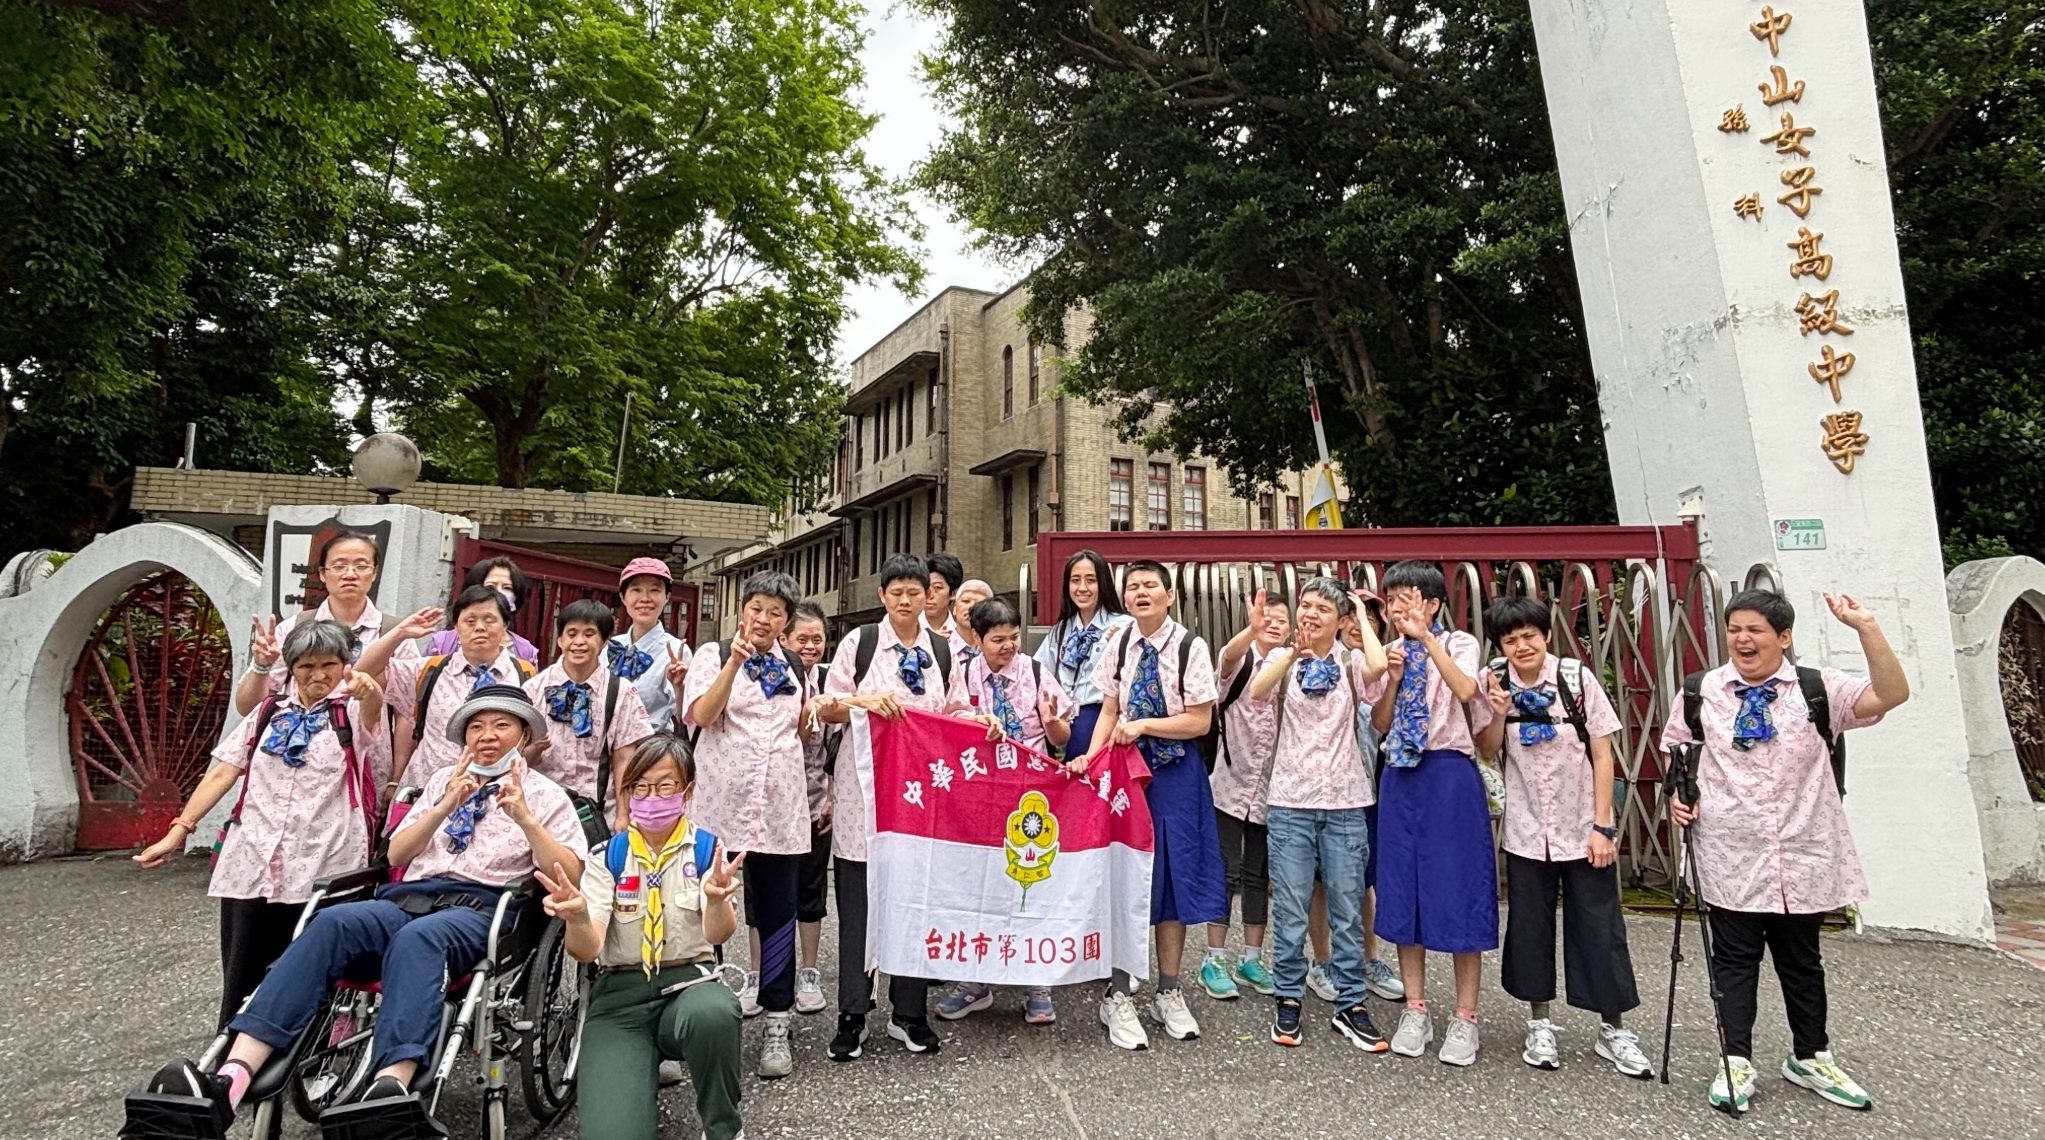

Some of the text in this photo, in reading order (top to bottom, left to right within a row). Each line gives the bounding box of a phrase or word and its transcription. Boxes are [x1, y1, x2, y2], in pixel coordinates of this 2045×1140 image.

[1749, 5, 1870, 474] 中山女子高級中學
[1793, 532, 1819, 546] 141
